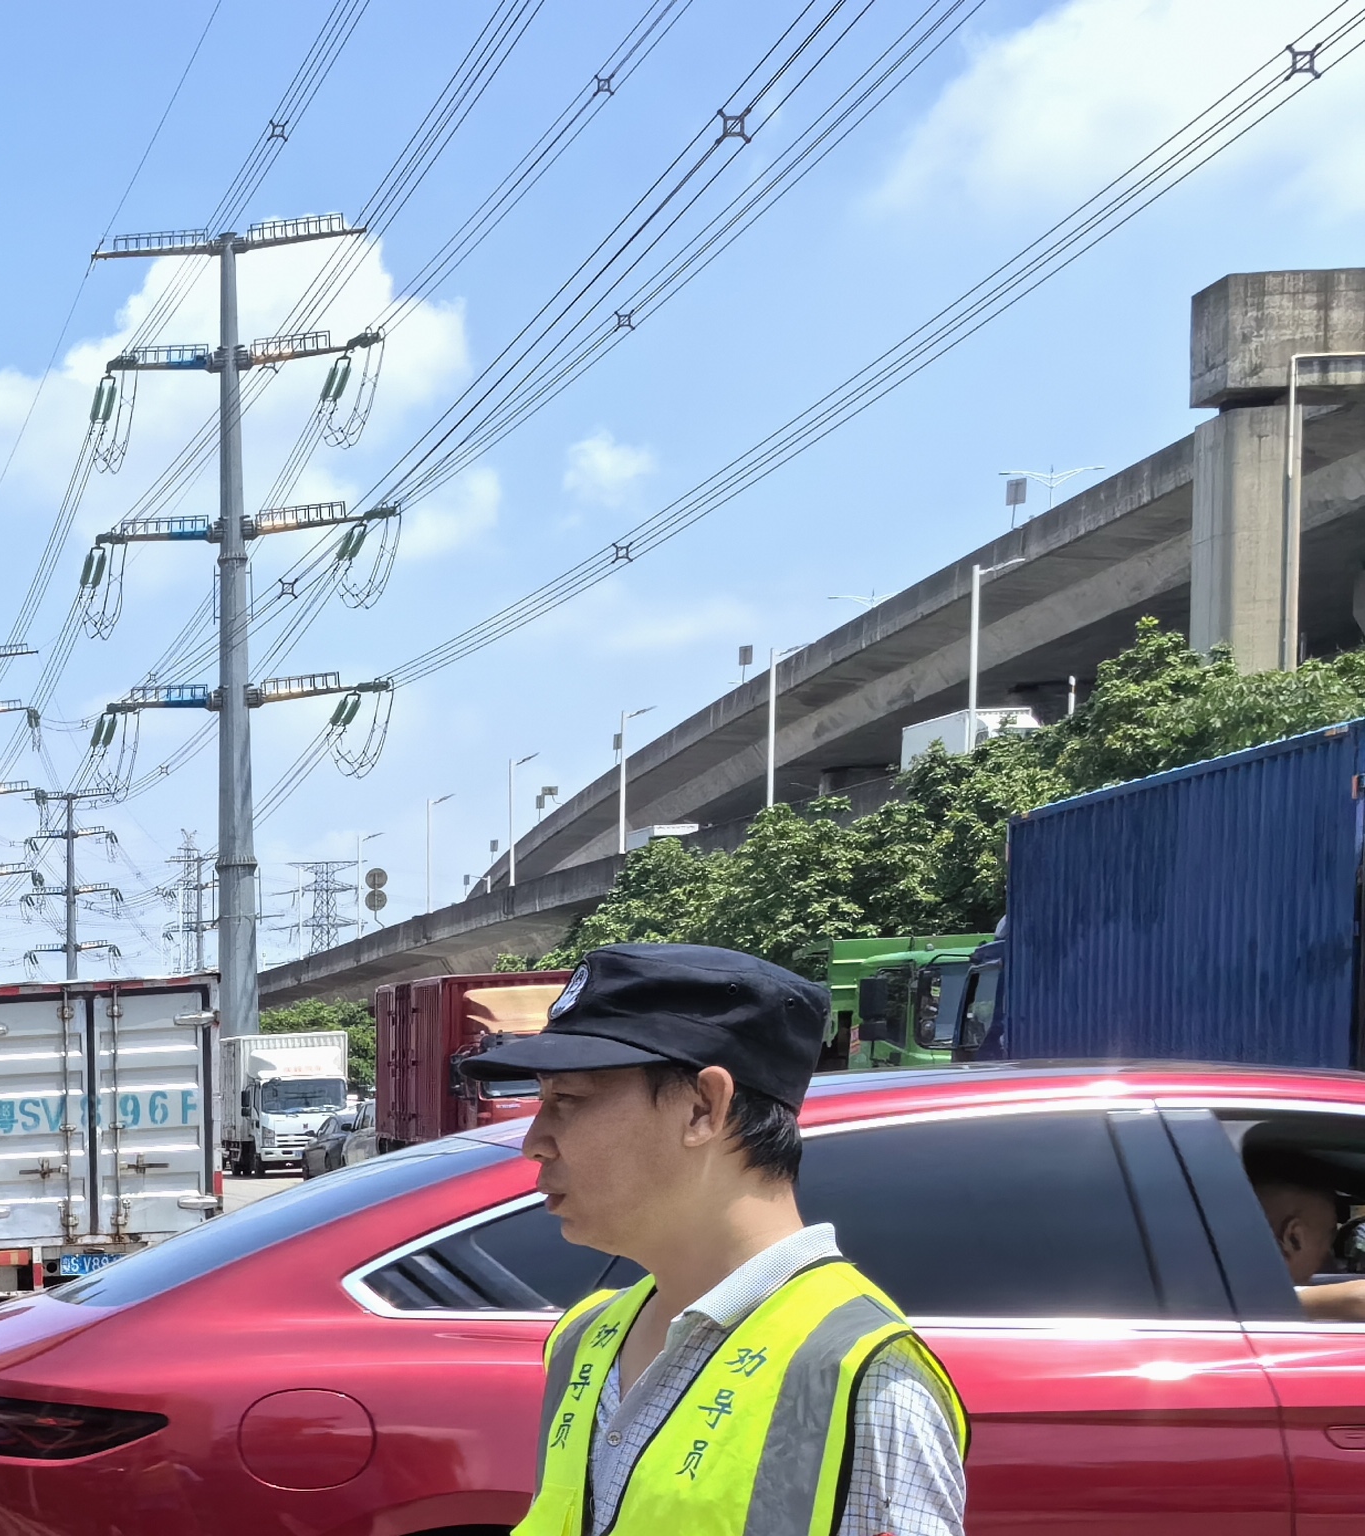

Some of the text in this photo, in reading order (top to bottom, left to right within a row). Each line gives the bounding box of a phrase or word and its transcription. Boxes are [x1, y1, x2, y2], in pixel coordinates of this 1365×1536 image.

[550, 1321, 618, 1450] 劝导员
[675, 1345, 768, 1481] 劝导员
